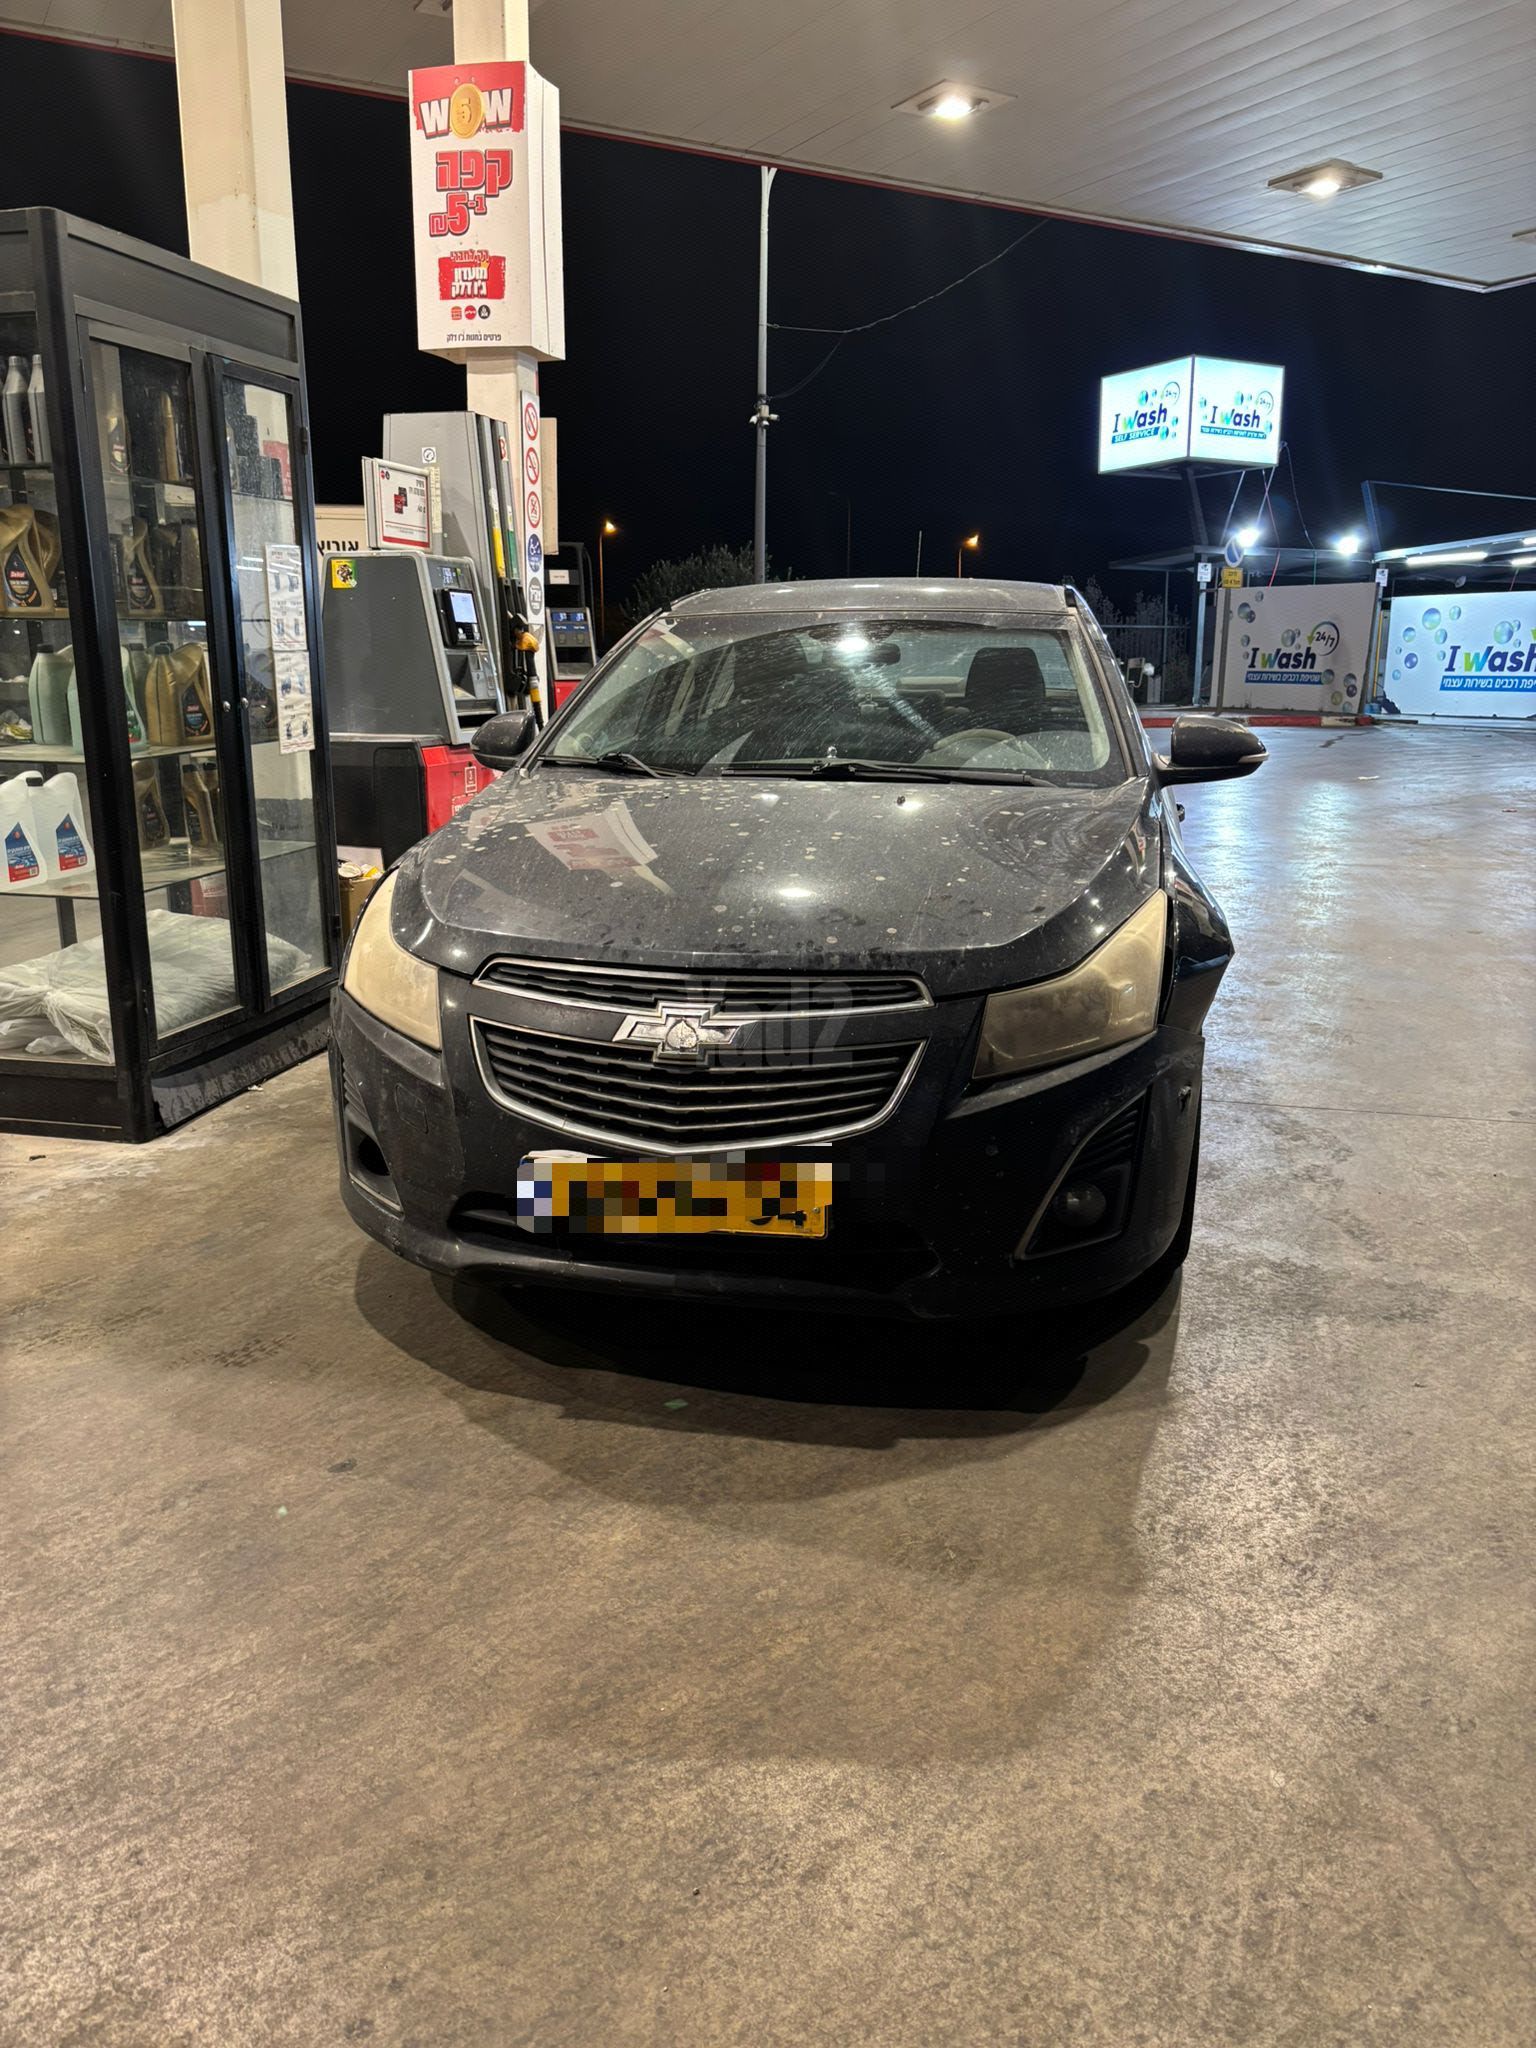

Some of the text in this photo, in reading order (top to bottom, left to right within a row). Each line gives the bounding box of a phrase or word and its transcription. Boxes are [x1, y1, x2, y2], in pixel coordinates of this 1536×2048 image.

[436, 149, 513, 198] קפה
[454, 267, 488, 282] מועדון
[1113, 413, 1120, 433] I
[1210, 406, 1218, 424] I
[1129, 428, 1155, 440] SERVICE
[1315, 631, 1335, 647] 24/7
[1248, 647, 1259, 668] I
[1444, 645, 1461, 672] I
[1443, 678, 1463, 688] עצמי
[1495, 678, 1518, 689] רכבים
